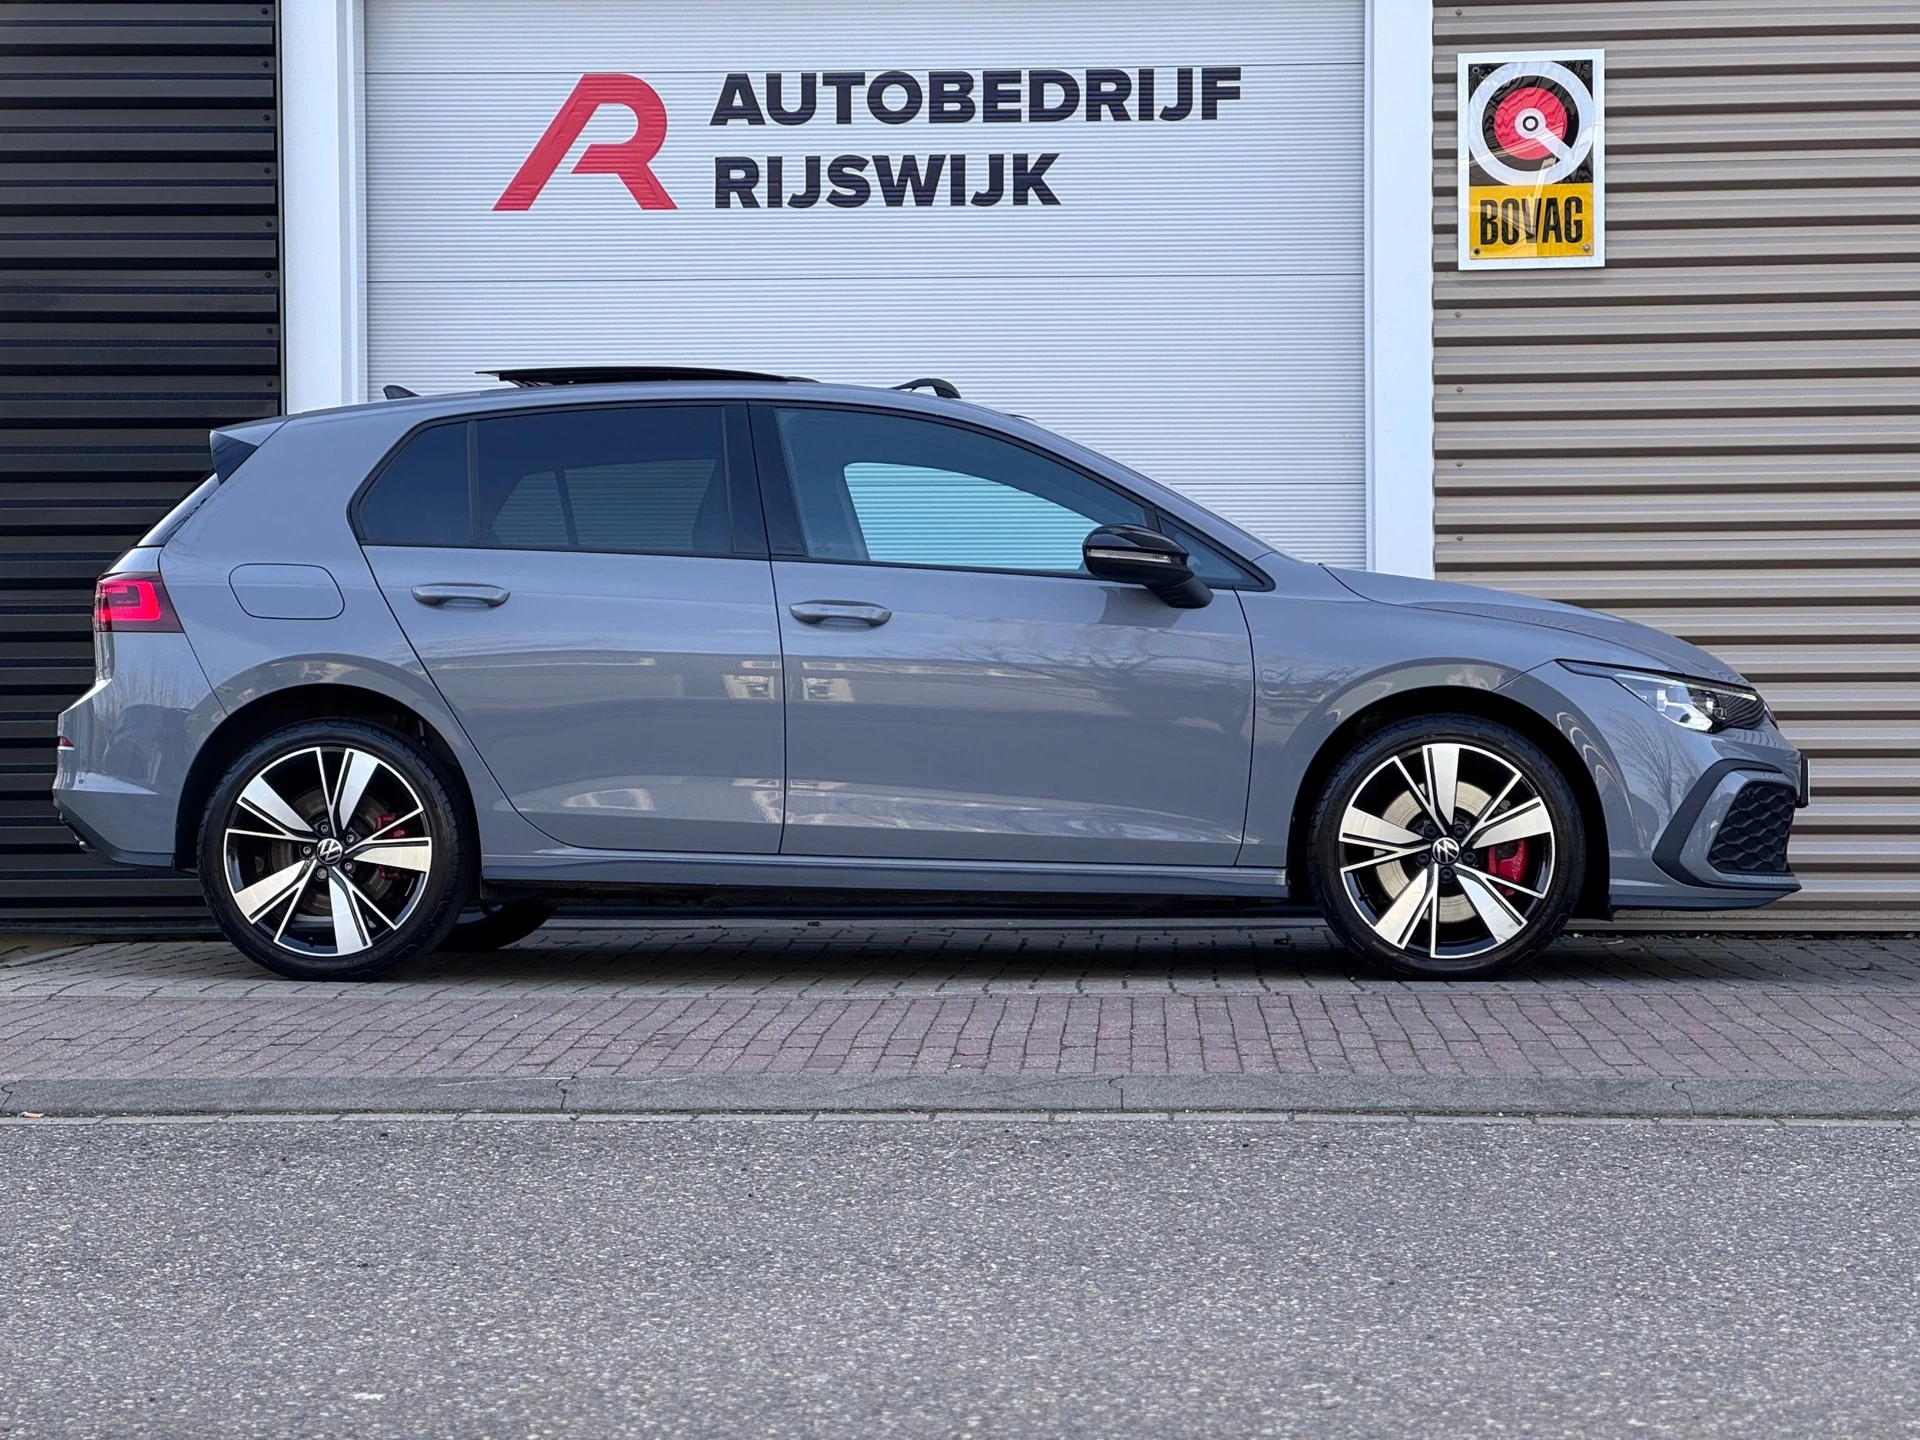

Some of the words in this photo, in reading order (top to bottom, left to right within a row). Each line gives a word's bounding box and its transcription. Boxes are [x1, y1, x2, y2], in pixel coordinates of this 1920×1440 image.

[709, 67, 1241, 126] AUTOBEDRIJF
[714, 153, 1061, 209] RIJSWIJK
[1480, 196, 1583, 246] BOVAG
